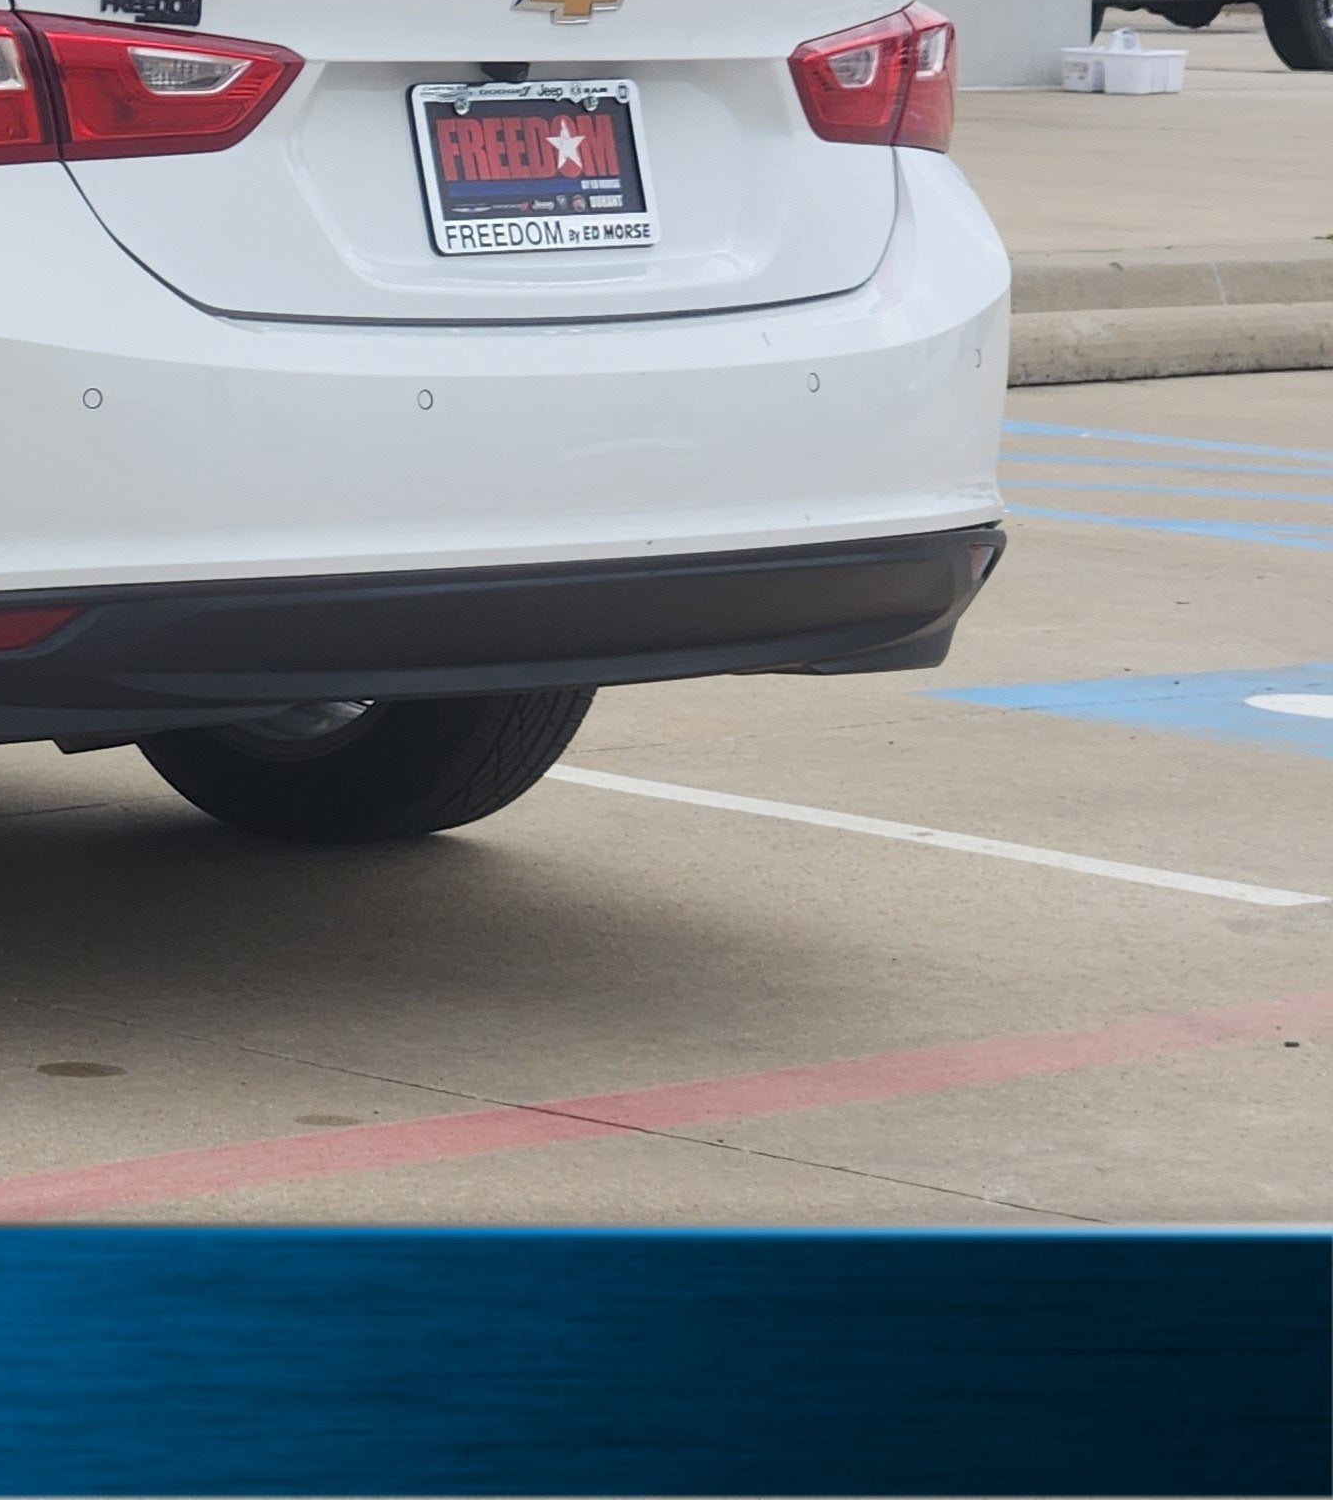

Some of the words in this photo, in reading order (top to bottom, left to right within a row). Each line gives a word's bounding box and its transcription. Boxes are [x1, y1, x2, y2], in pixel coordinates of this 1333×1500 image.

[537, 84, 563, 98] Jeep
[435, 113, 621, 182] FREEDOM
[445, 219, 565, 249] FREEDOM
[583, 224, 599, 239] ED
[604, 222, 651, 240] MORSE
